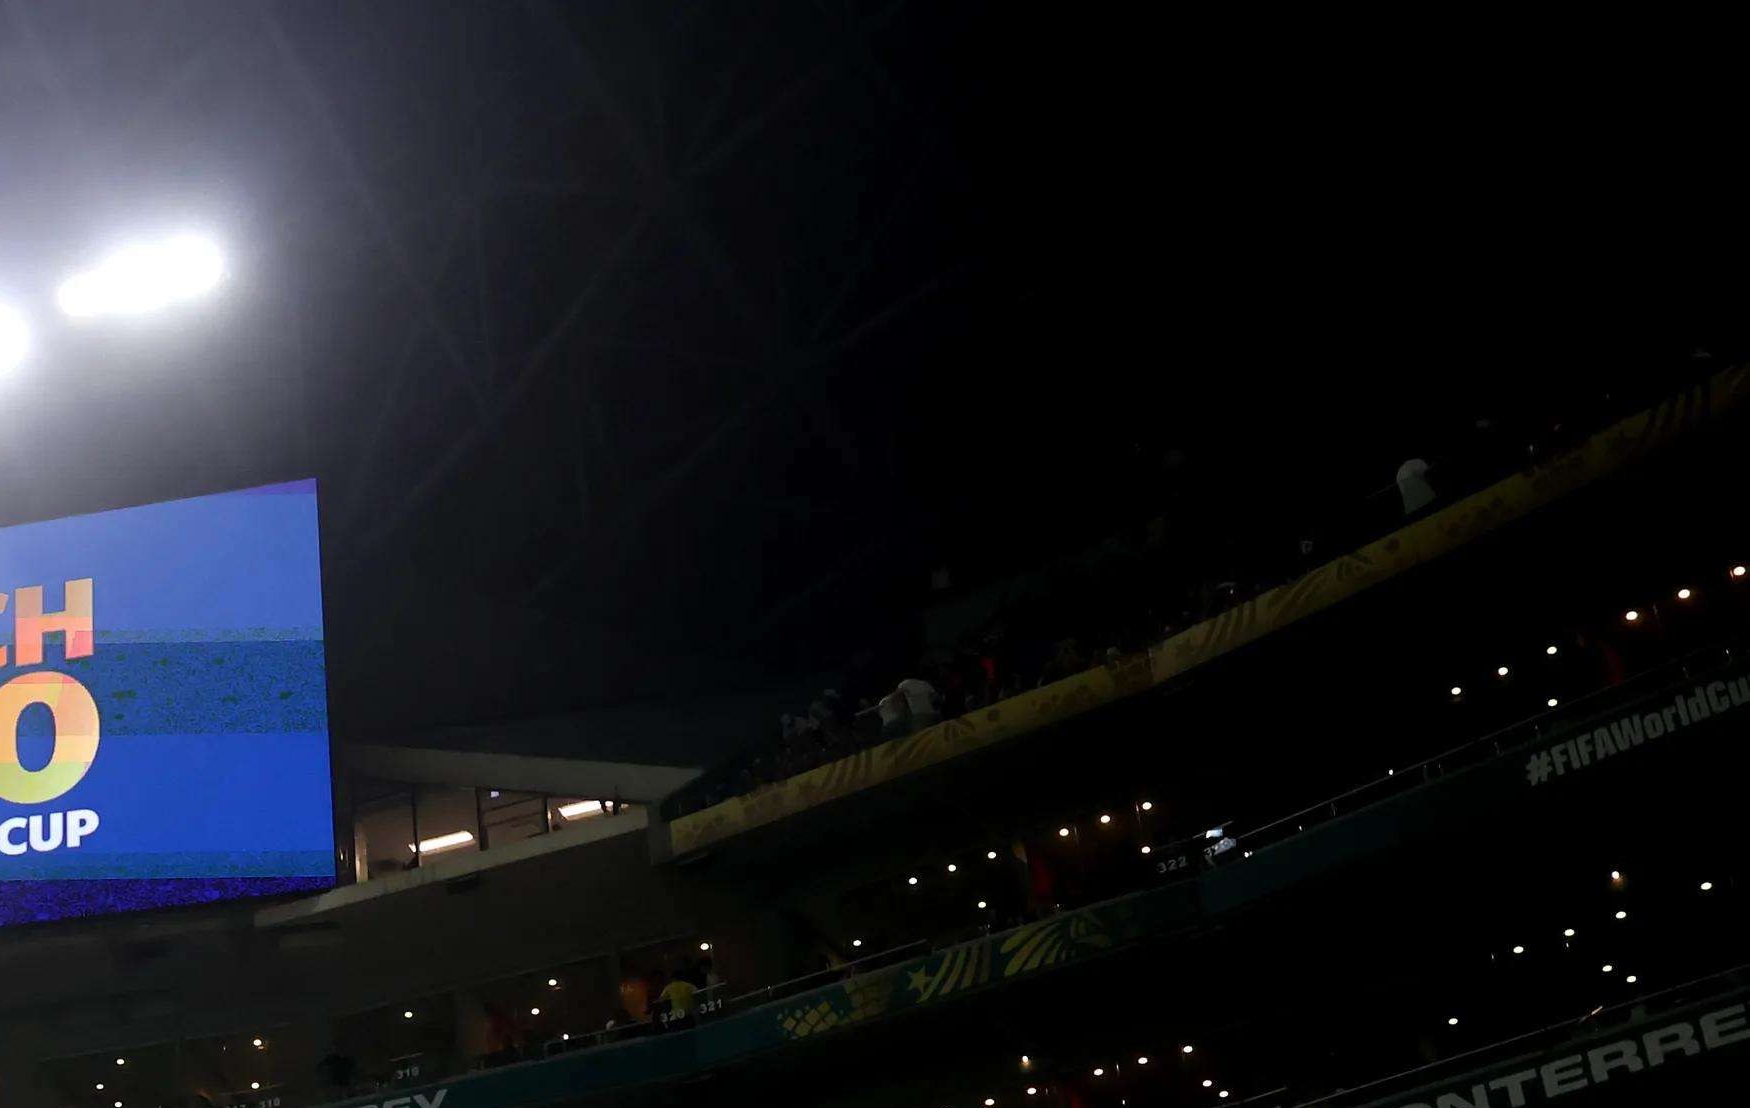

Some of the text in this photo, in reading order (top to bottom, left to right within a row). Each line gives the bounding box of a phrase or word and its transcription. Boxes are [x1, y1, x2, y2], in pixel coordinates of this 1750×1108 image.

[1524, 672, 1750, 787] #FIFAWorldCu
[1156, 856, 1187, 875] 322
[698, 998, 723, 1015] 321
